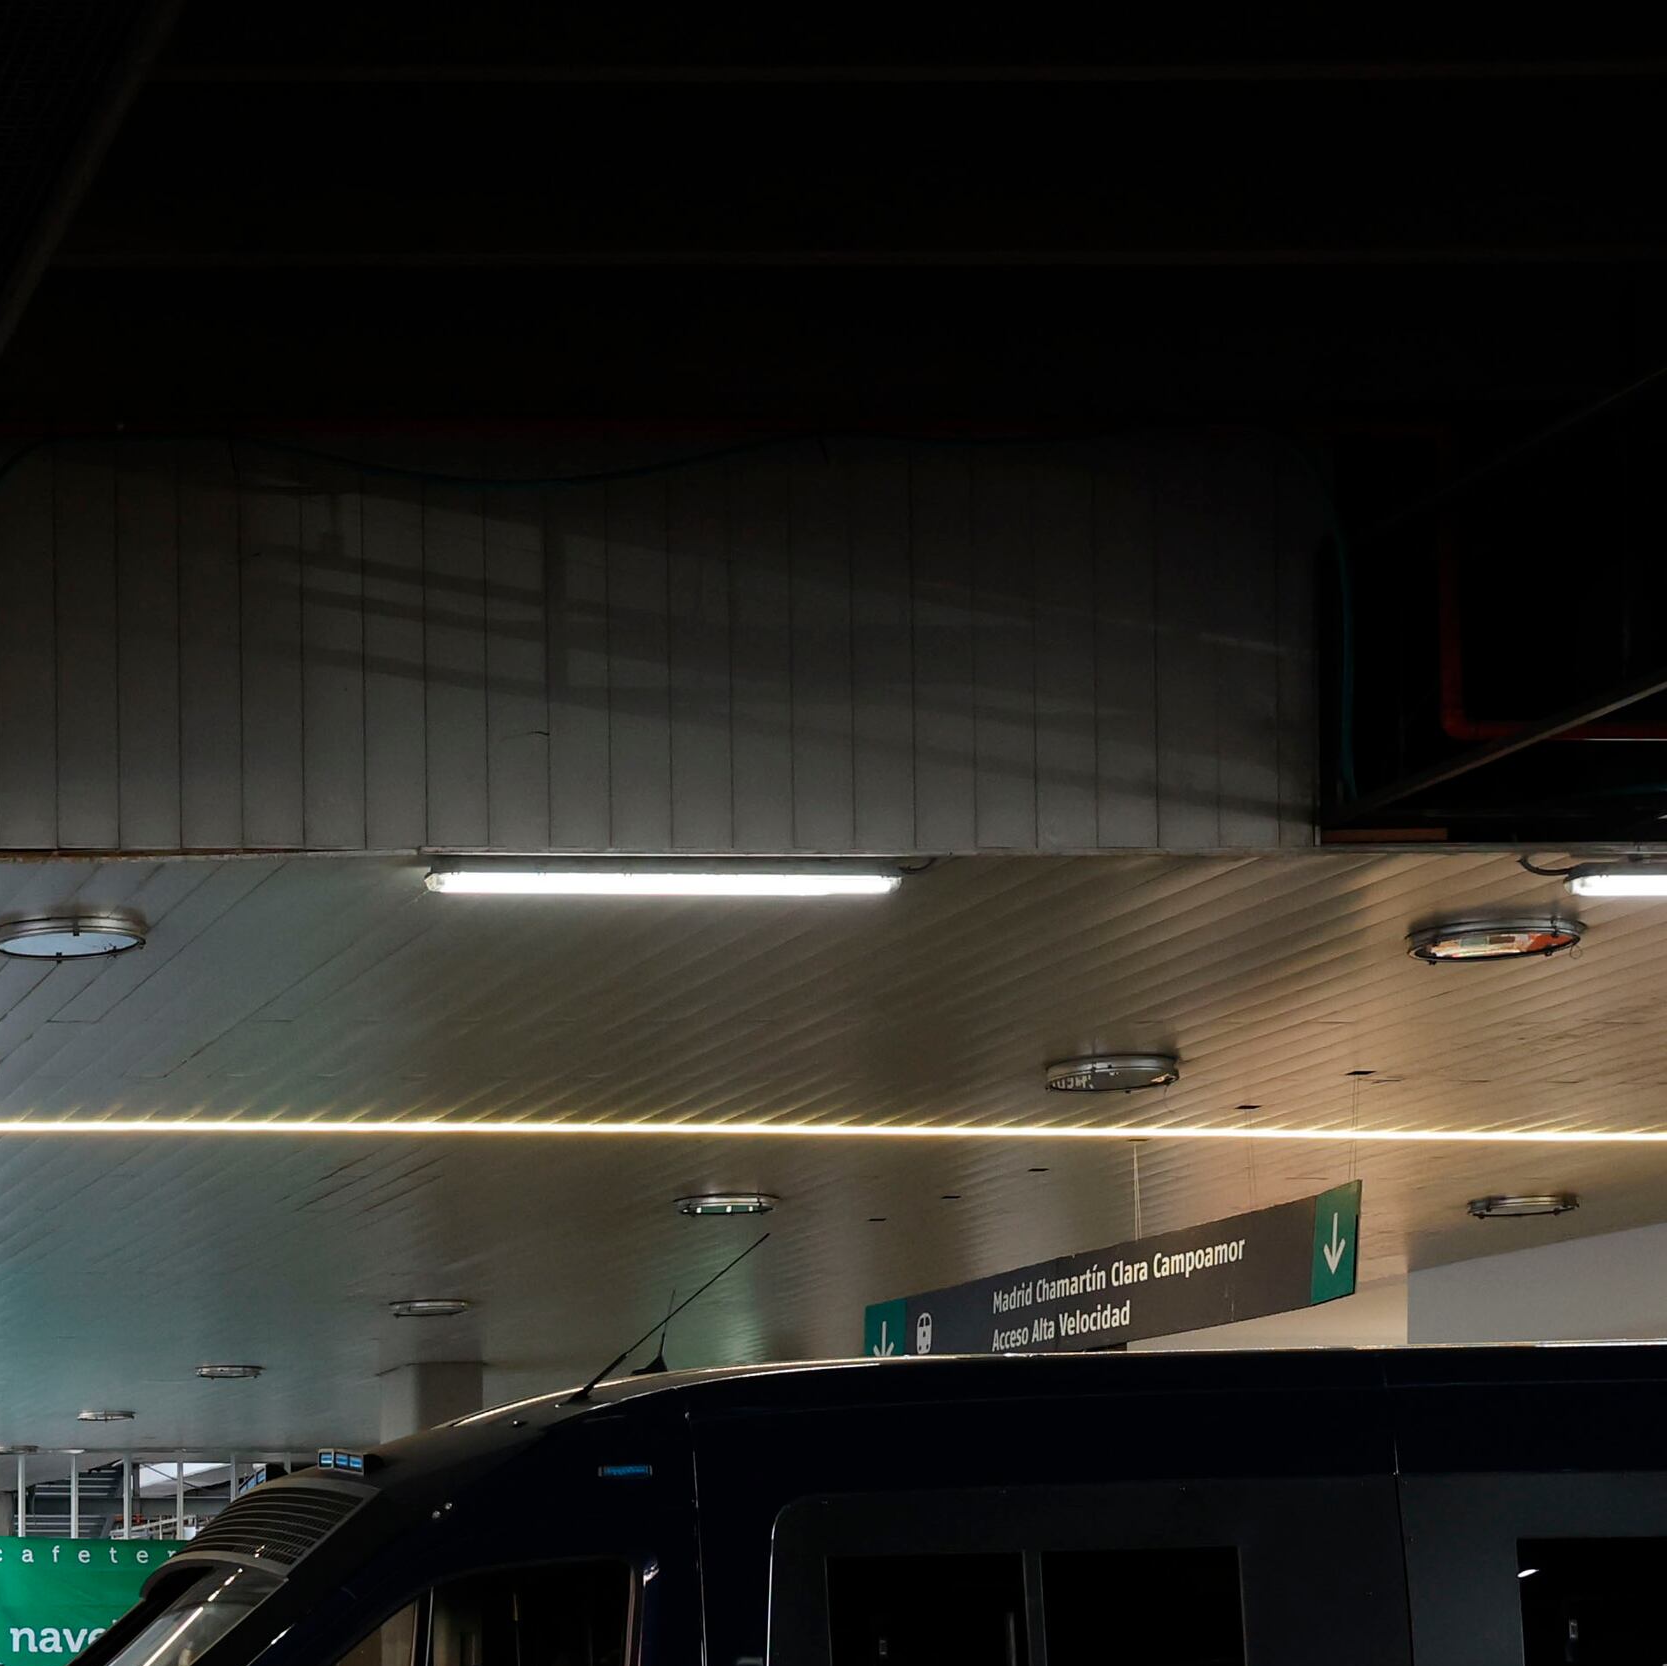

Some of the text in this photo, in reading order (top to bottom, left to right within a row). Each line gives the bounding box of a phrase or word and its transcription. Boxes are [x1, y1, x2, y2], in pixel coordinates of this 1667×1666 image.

[993, 1238, 1246, 1314] Madrid Chamartín Clara Campoamor
[992, 1300, 1130, 1352] Acceso Alta Velocidad
